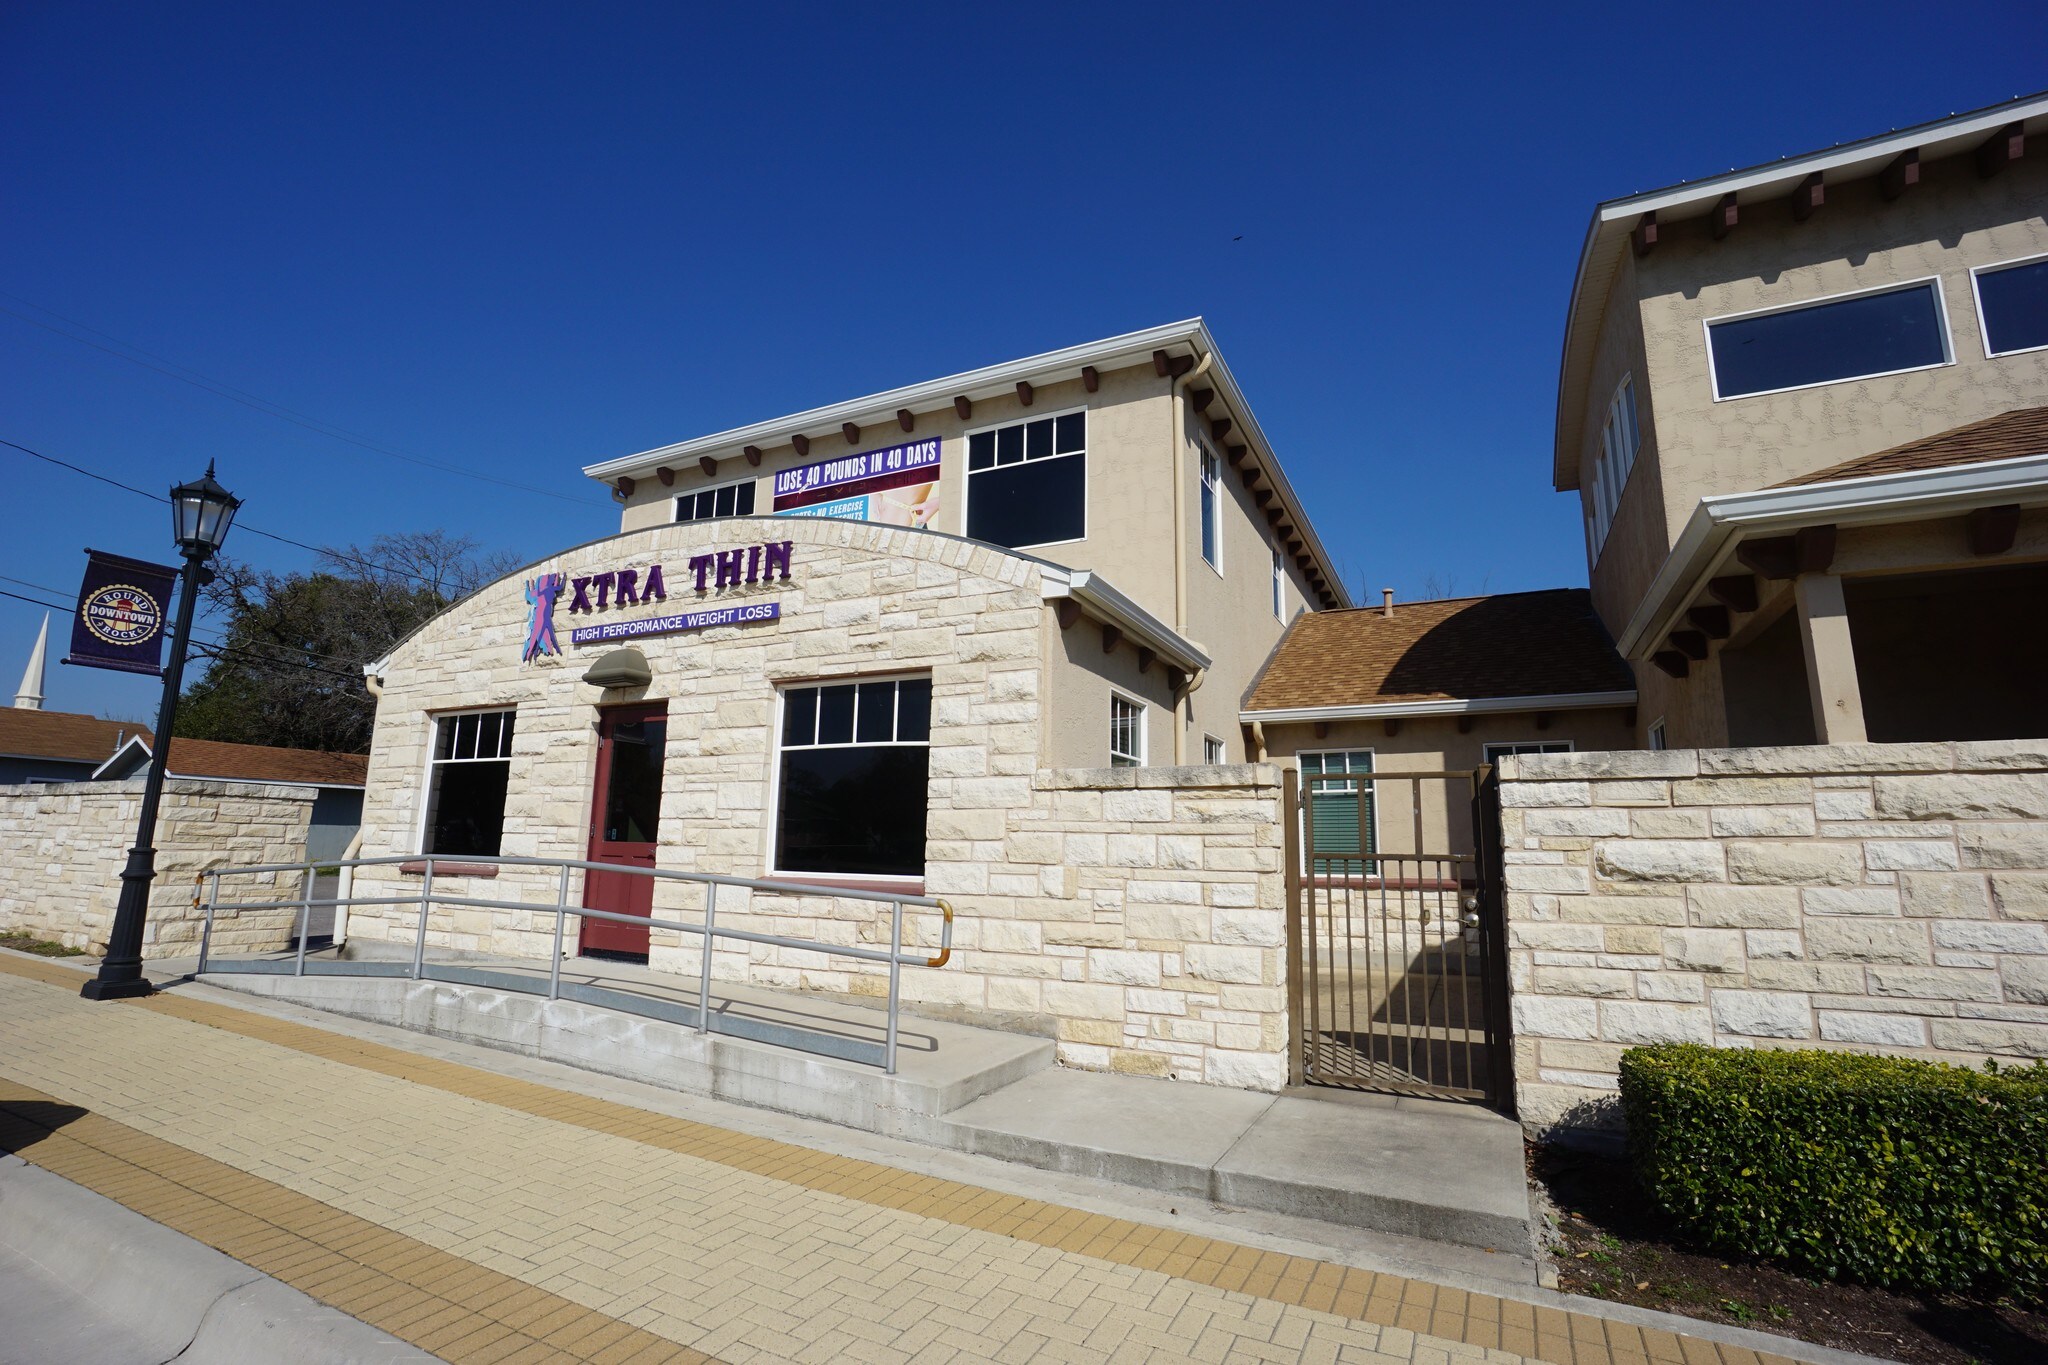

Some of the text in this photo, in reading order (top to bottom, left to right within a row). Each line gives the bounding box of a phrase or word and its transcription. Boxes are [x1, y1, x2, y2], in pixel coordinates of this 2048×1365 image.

[778, 469, 803, 492] LOSE
[806, 466, 820, 485] 40
[824, 456, 866, 483] POUNDS
[870, 452, 882, 473] IN
[887, 448, 902, 469] 40
[906, 441, 936, 466] DAYS
[816, 507, 827, 517] NO
[829, 500, 864, 516] EXERCISE
[568, 540, 794, 611] XTRA THIN
[102, 592, 148, 610] ROUND
[90, 605, 155, 624] DOWNTOWN
[576, 605, 773, 641] HIGH PERFORMANCE WEIGHT LOSS
[102, 625, 137, 638] ROCK
